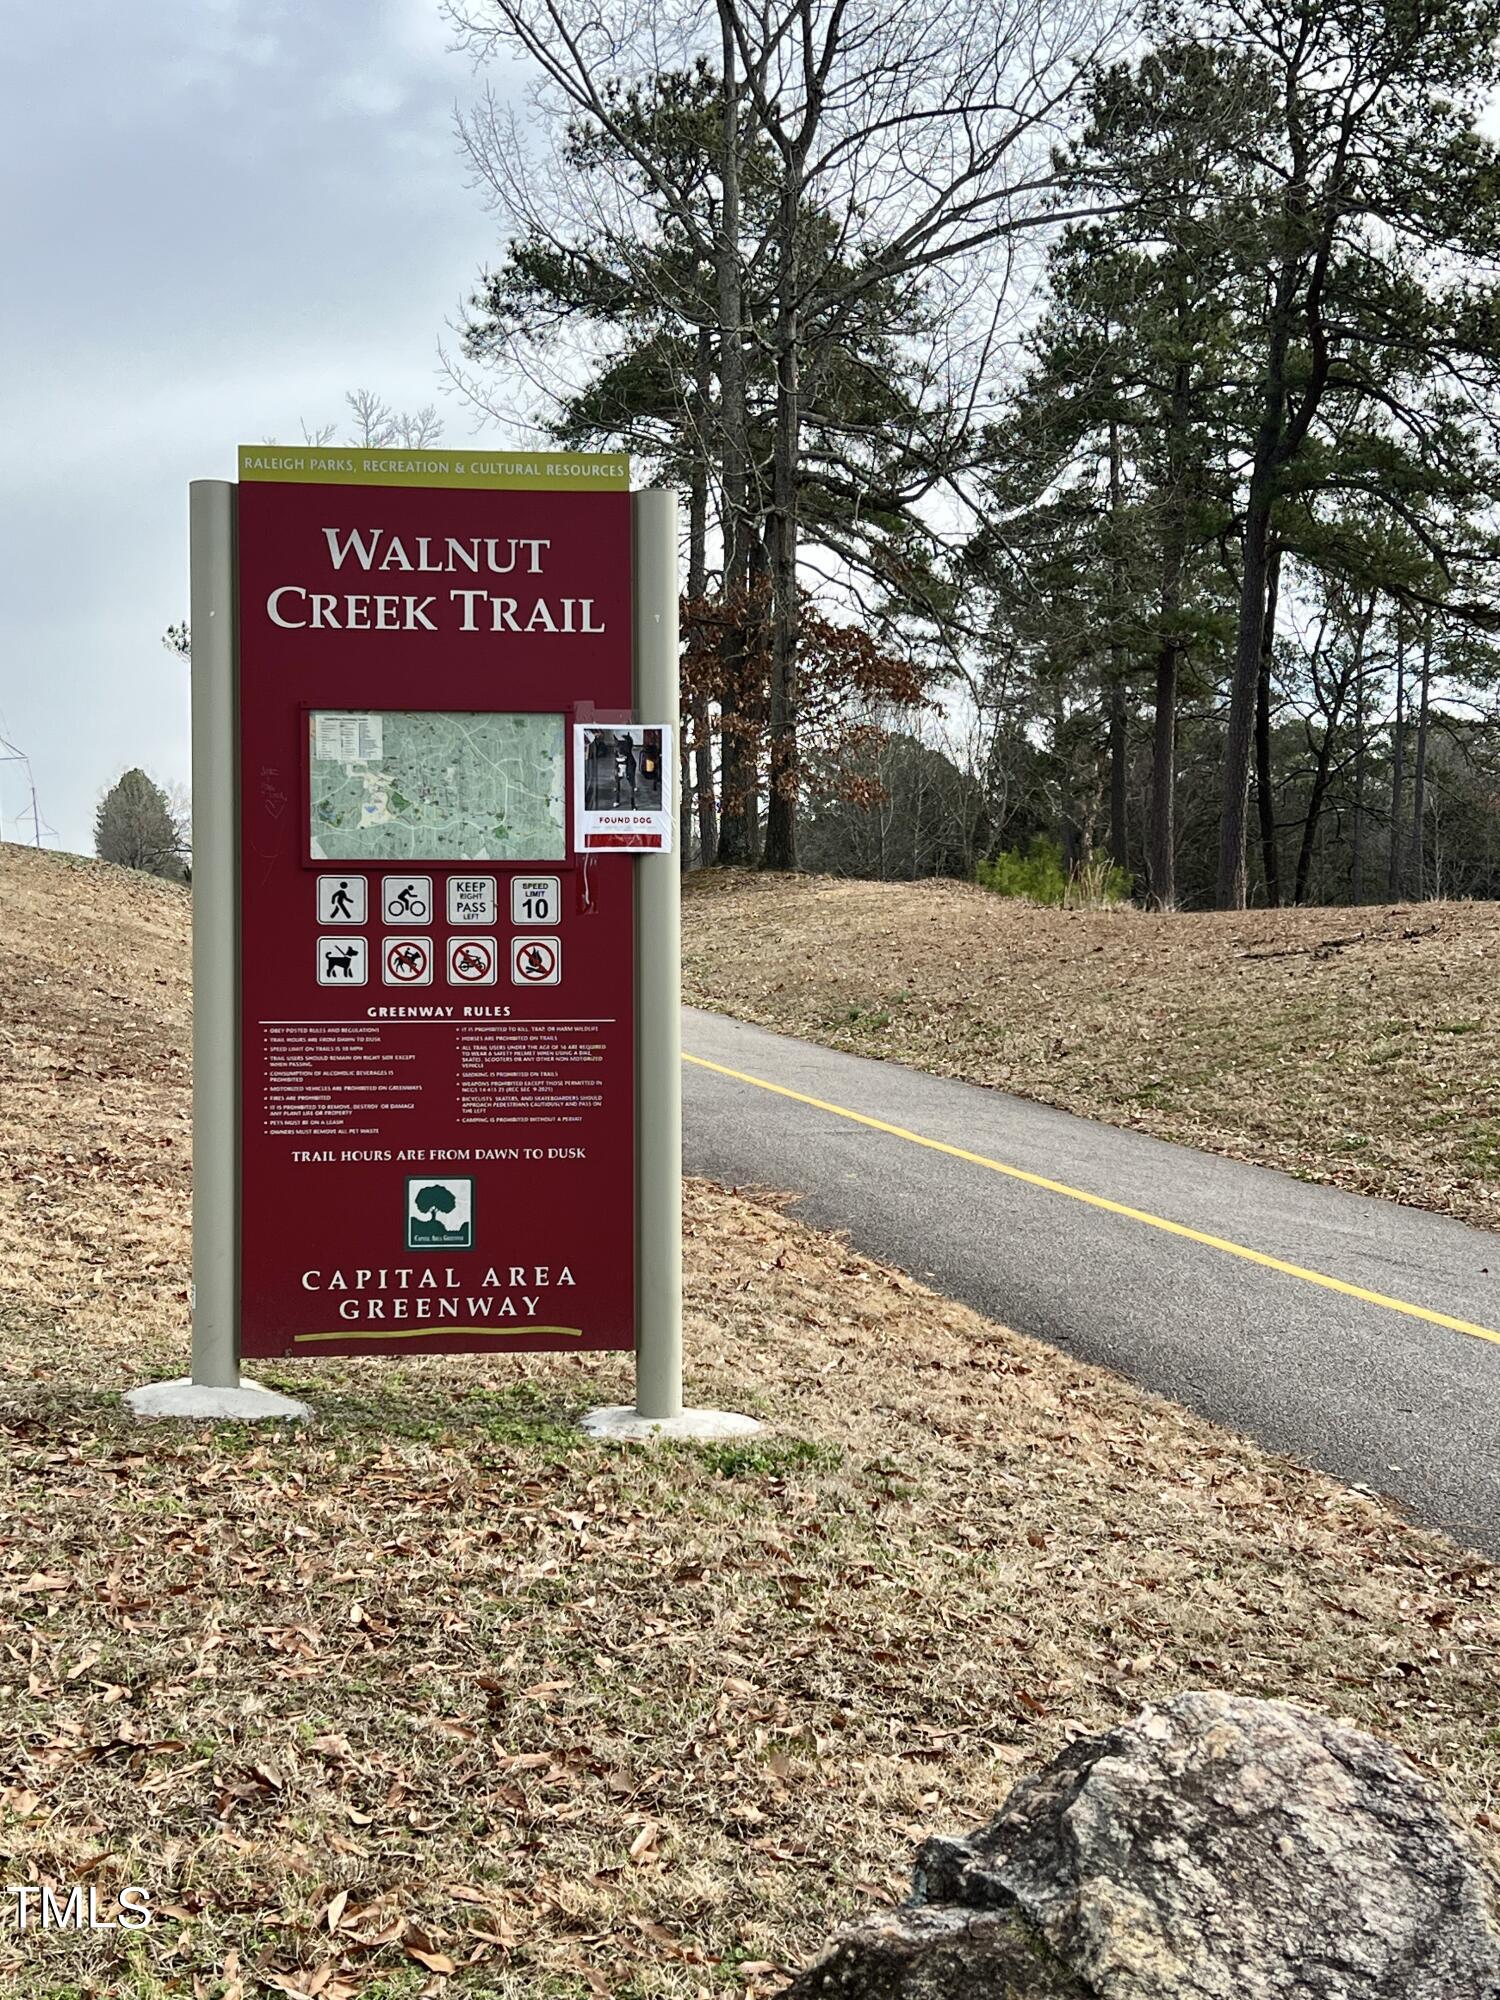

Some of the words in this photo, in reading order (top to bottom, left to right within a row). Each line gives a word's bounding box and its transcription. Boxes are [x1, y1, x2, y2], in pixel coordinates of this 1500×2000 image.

[244, 457, 304, 470] RALEIGH
[310, 459, 357, 472] PARKS,
[364, 460, 448, 473] RECREATION
[455, 462, 464, 474] &
[470, 462, 540, 476] CULTURAL
[546, 464, 624, 477] RESOURCES
[322, 528, 550, 574] WALNUT
[266, 586, 438, 631] CREEK
[450, 590, 606, 633] TRAIL
[456, 882, 486, 892] KEEP
[456, 902, 486, 912] PASS
[522, 898, 549, 919] 10
[368, 1006, 454, 1018] GREENWAY
[463, 1006, 512, 1017] RULES
[292, 1151, 336, 1162] TRAIL
[340, 1150, 392, 1162] HOURS
[396, 1150, 425, 1160] ARE
[430, 1150, 470, 1160] FROM
[475, 1149, 519, 1160] DAWN
[524, 1148, 543, 1160] TO
[548, 1148, 586, 1159] DUSK
[302, 1268, 462, 1292] CAPITAL
[482, 1266, 576, 1287] AREA
[340, 1296, 540, 1320] GREENWAY
